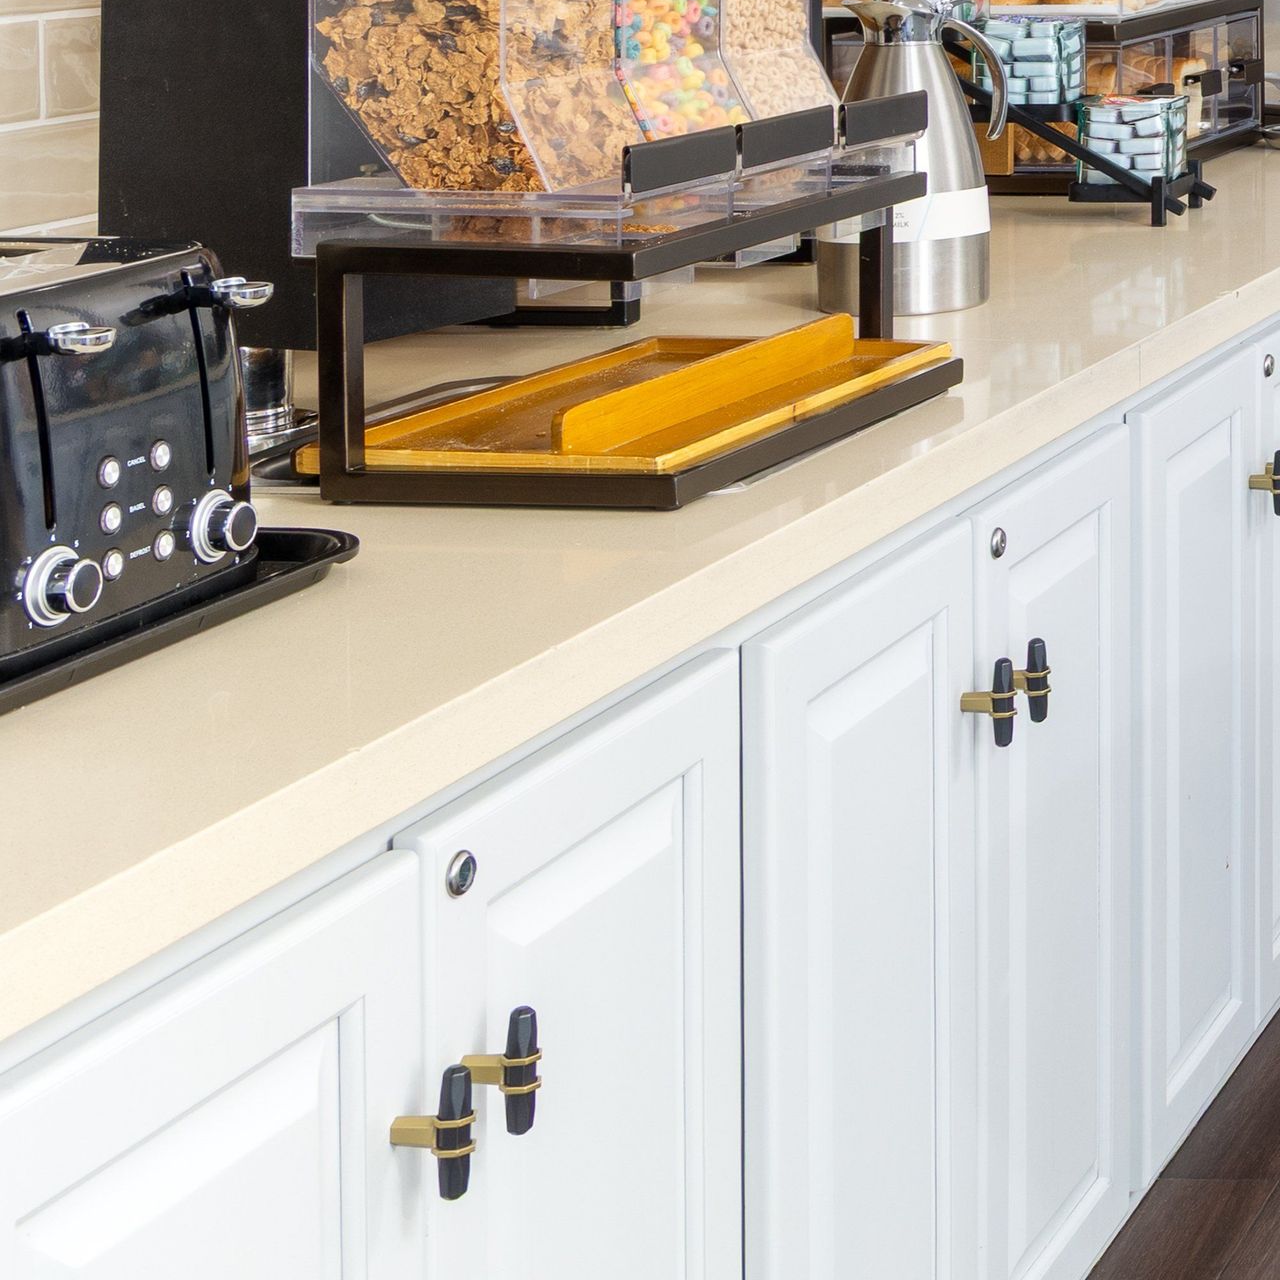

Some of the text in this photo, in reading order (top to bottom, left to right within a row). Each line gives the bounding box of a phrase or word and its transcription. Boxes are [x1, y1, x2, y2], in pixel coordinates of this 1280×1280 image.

[127, 455, 146, 467] CANCEL
[129, 502, 146, 513] BAGEL
[129, 545, 151, 559] DEFROST
